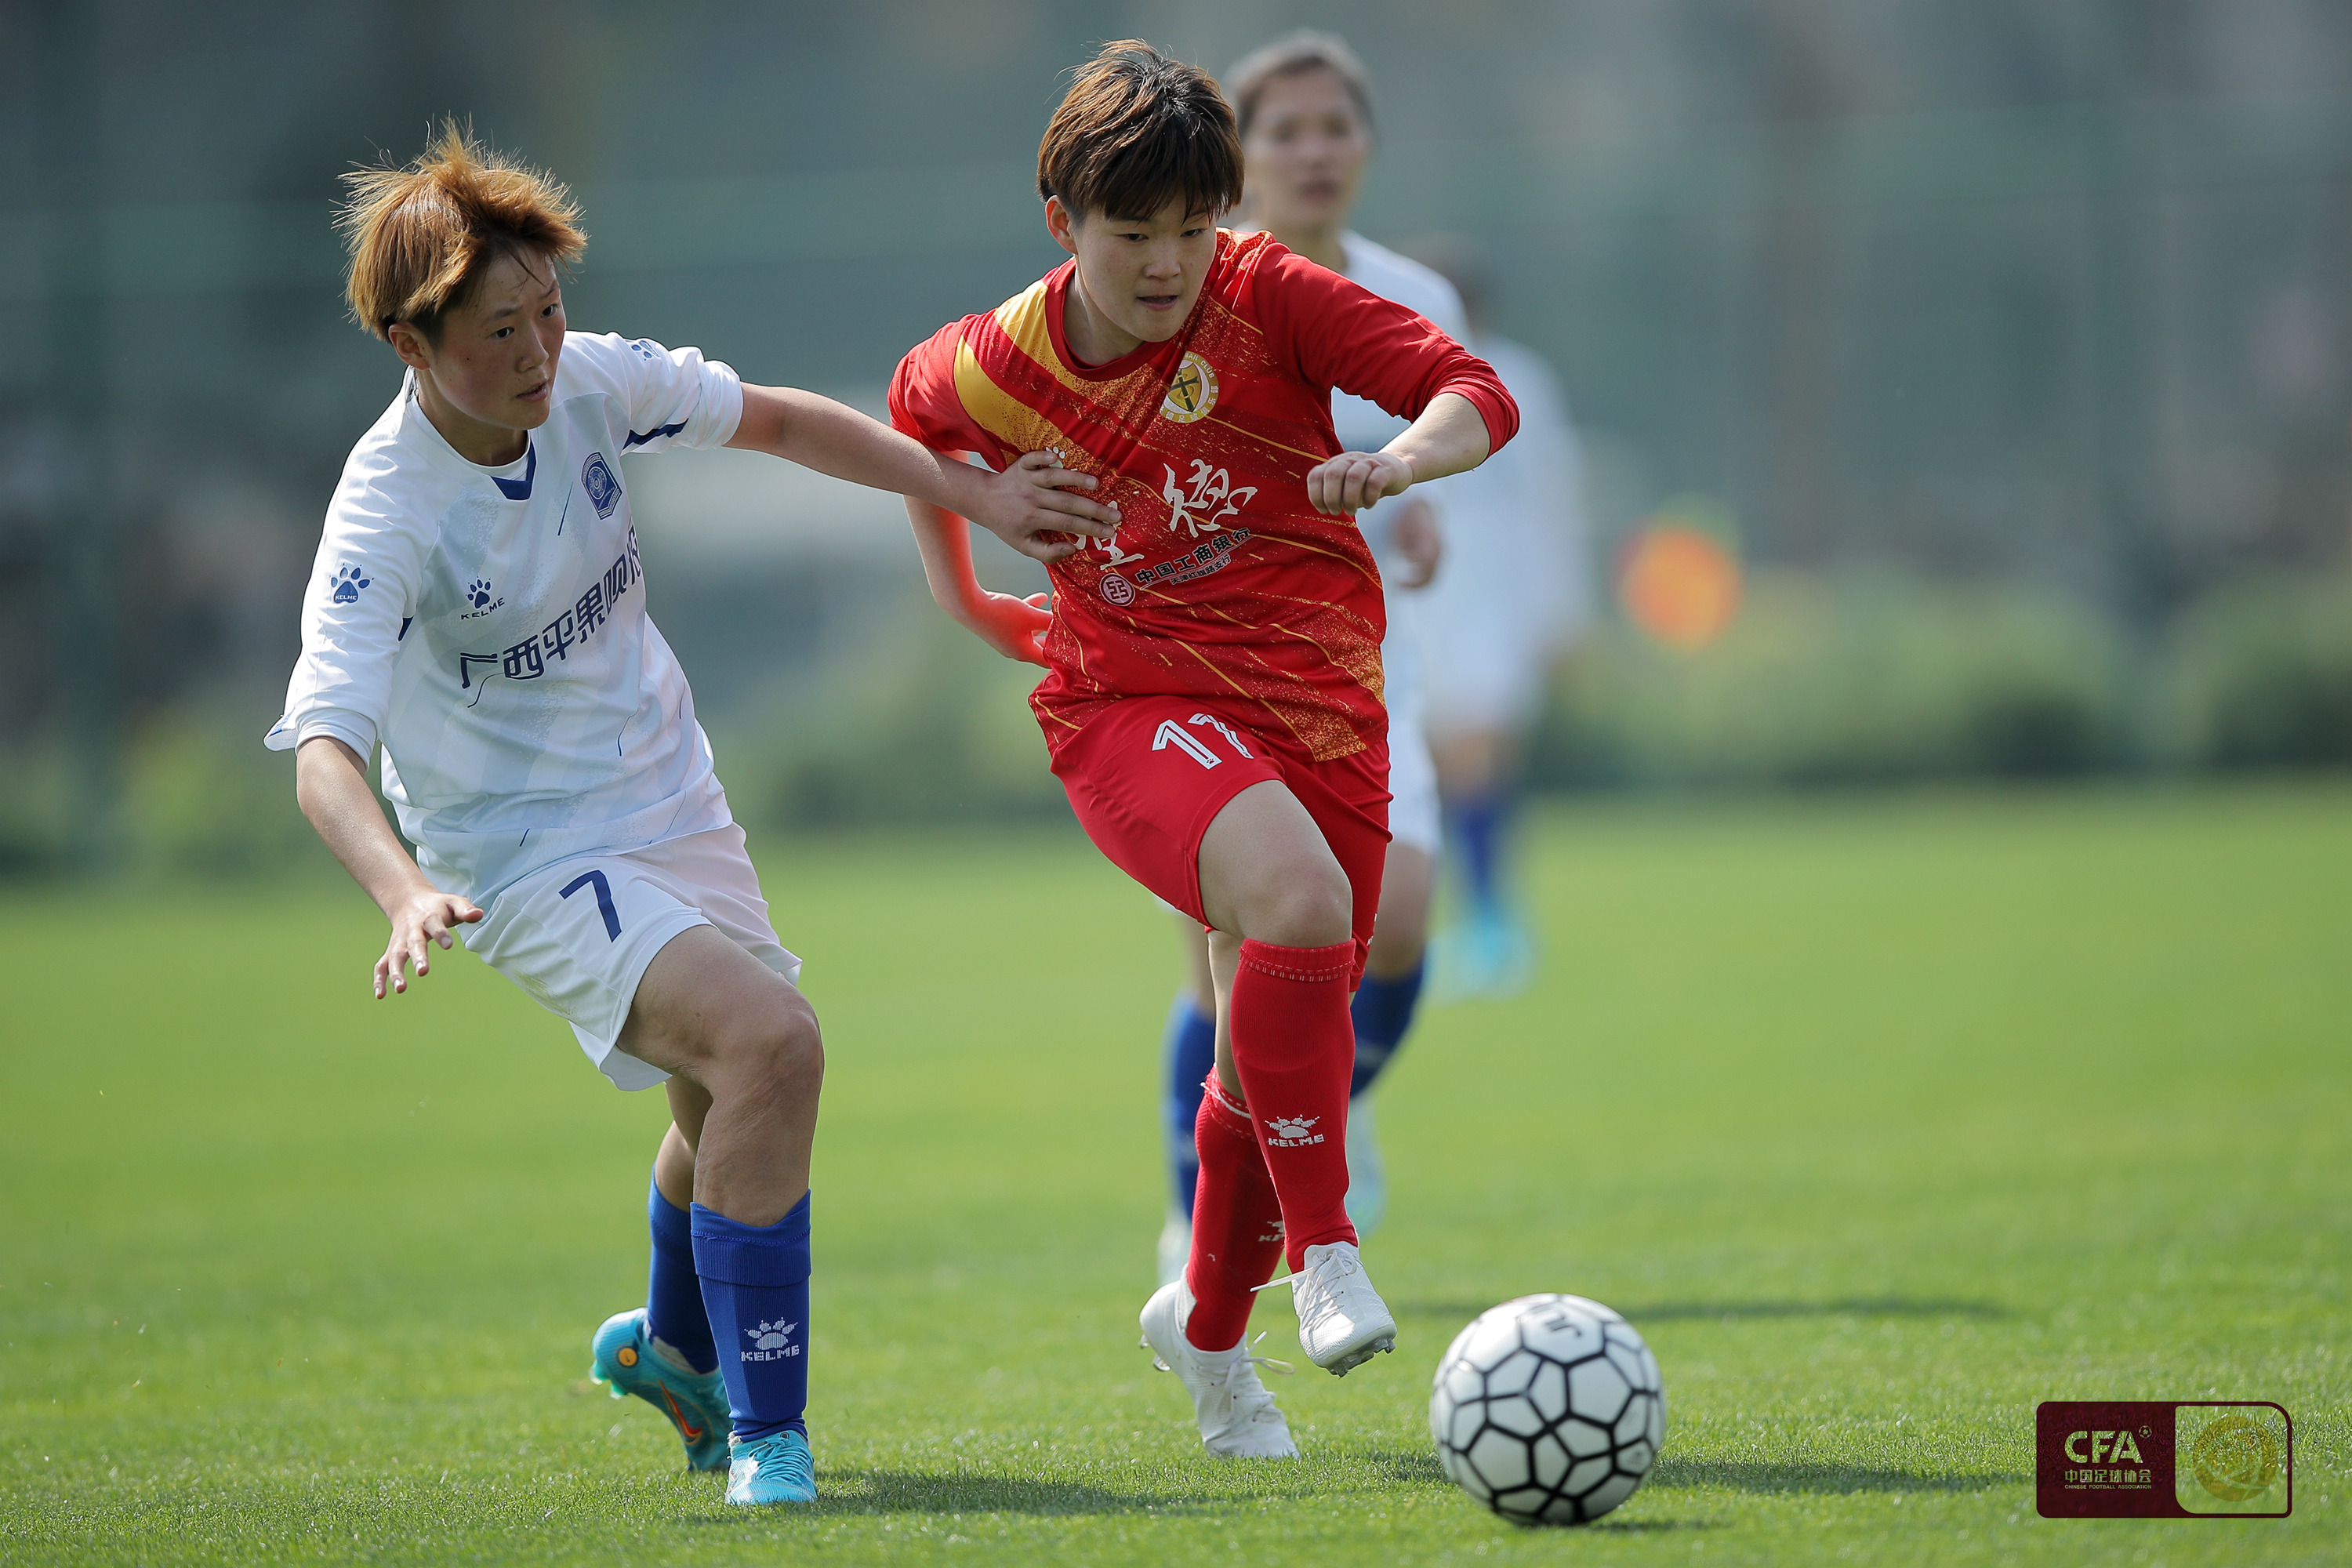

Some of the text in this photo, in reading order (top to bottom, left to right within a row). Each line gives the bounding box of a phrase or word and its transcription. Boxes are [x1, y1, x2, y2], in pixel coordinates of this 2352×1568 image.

[1200, 360, 1215, 379] CLUB
[1135, 527, 1251, 583] 中国工商银行
[1171, 554, 1232, 586] 天津红旗路支行
[461, 597, 505, 620] KELME
[1151, 712, 1254, 771] 11
[558, 869, 622, 943] 7
[1266, 1134, 1325, 1148] KELME
[741, 1345, 800, 1362] KELME
